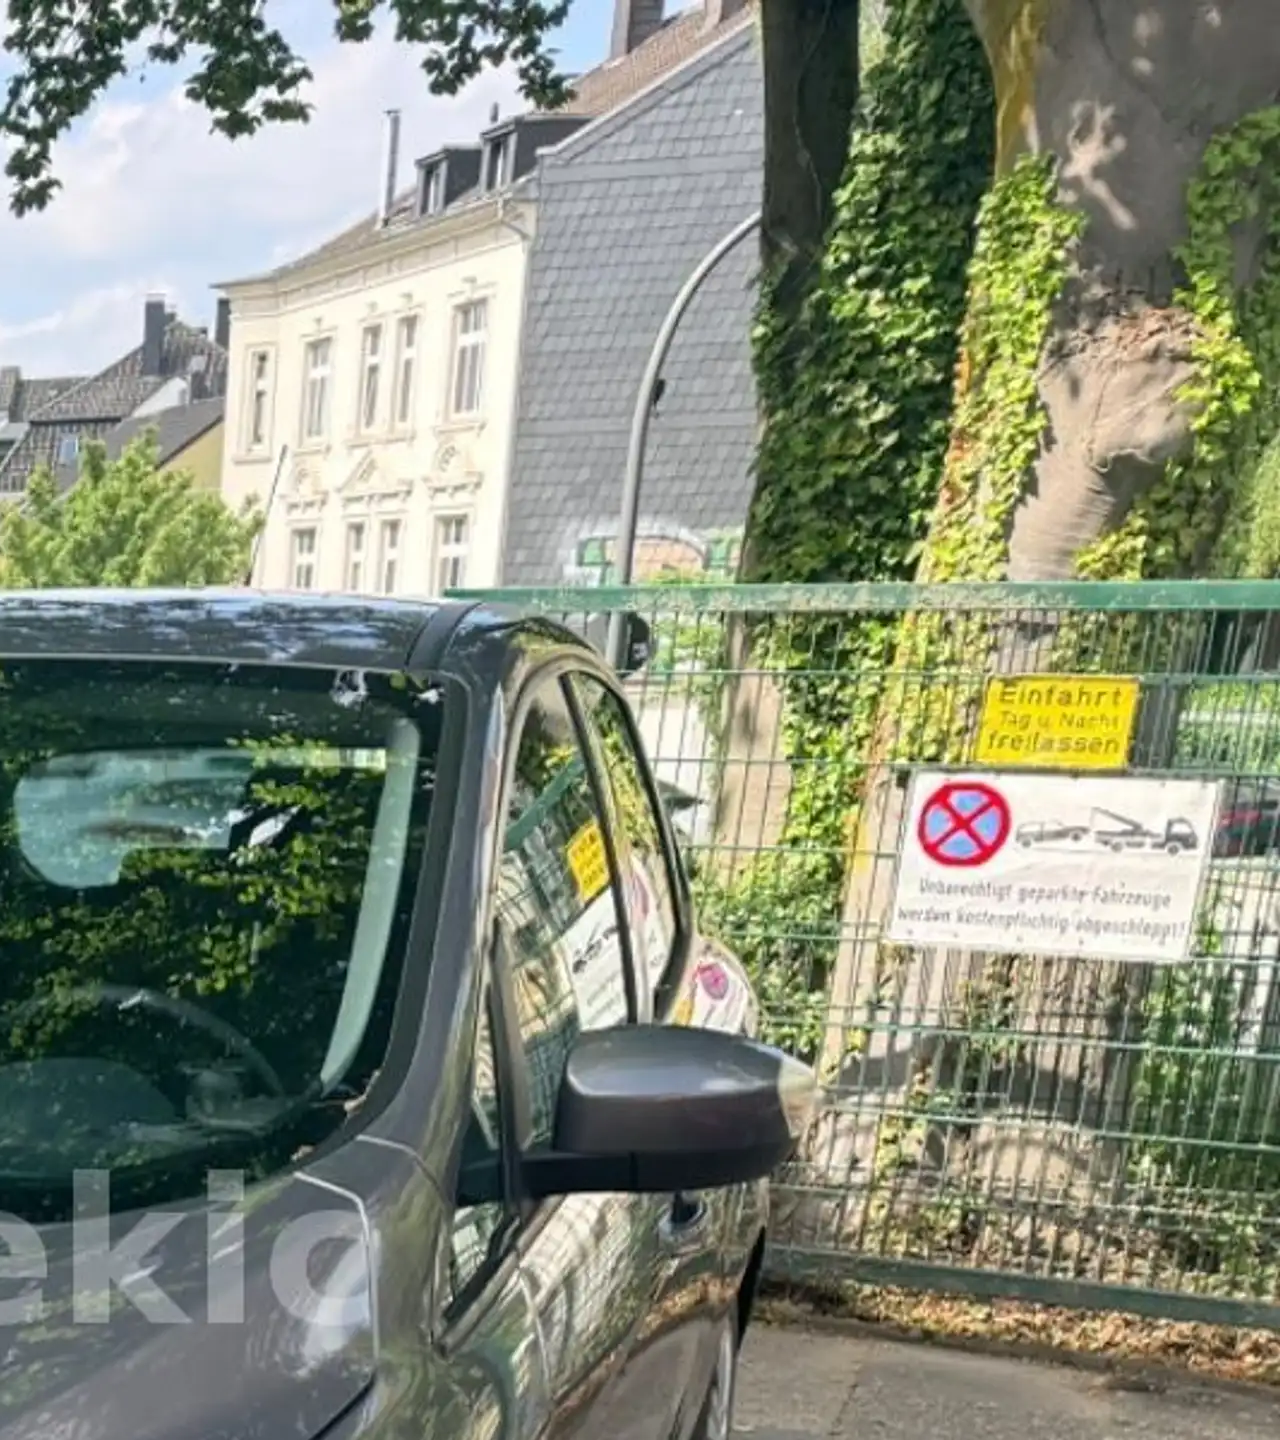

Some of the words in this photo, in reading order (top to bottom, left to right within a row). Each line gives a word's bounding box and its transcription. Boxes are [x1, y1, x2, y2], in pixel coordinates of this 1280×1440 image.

[999, 682, 1122, 707] Einfahrt
[1000, 710, 1032, 731] Tag
[1059, 711, 1121, 731] Nacht
[987, 730, 1121, 755] freilassen
[1092, 885, 1171, 912] Fahrzeuge
